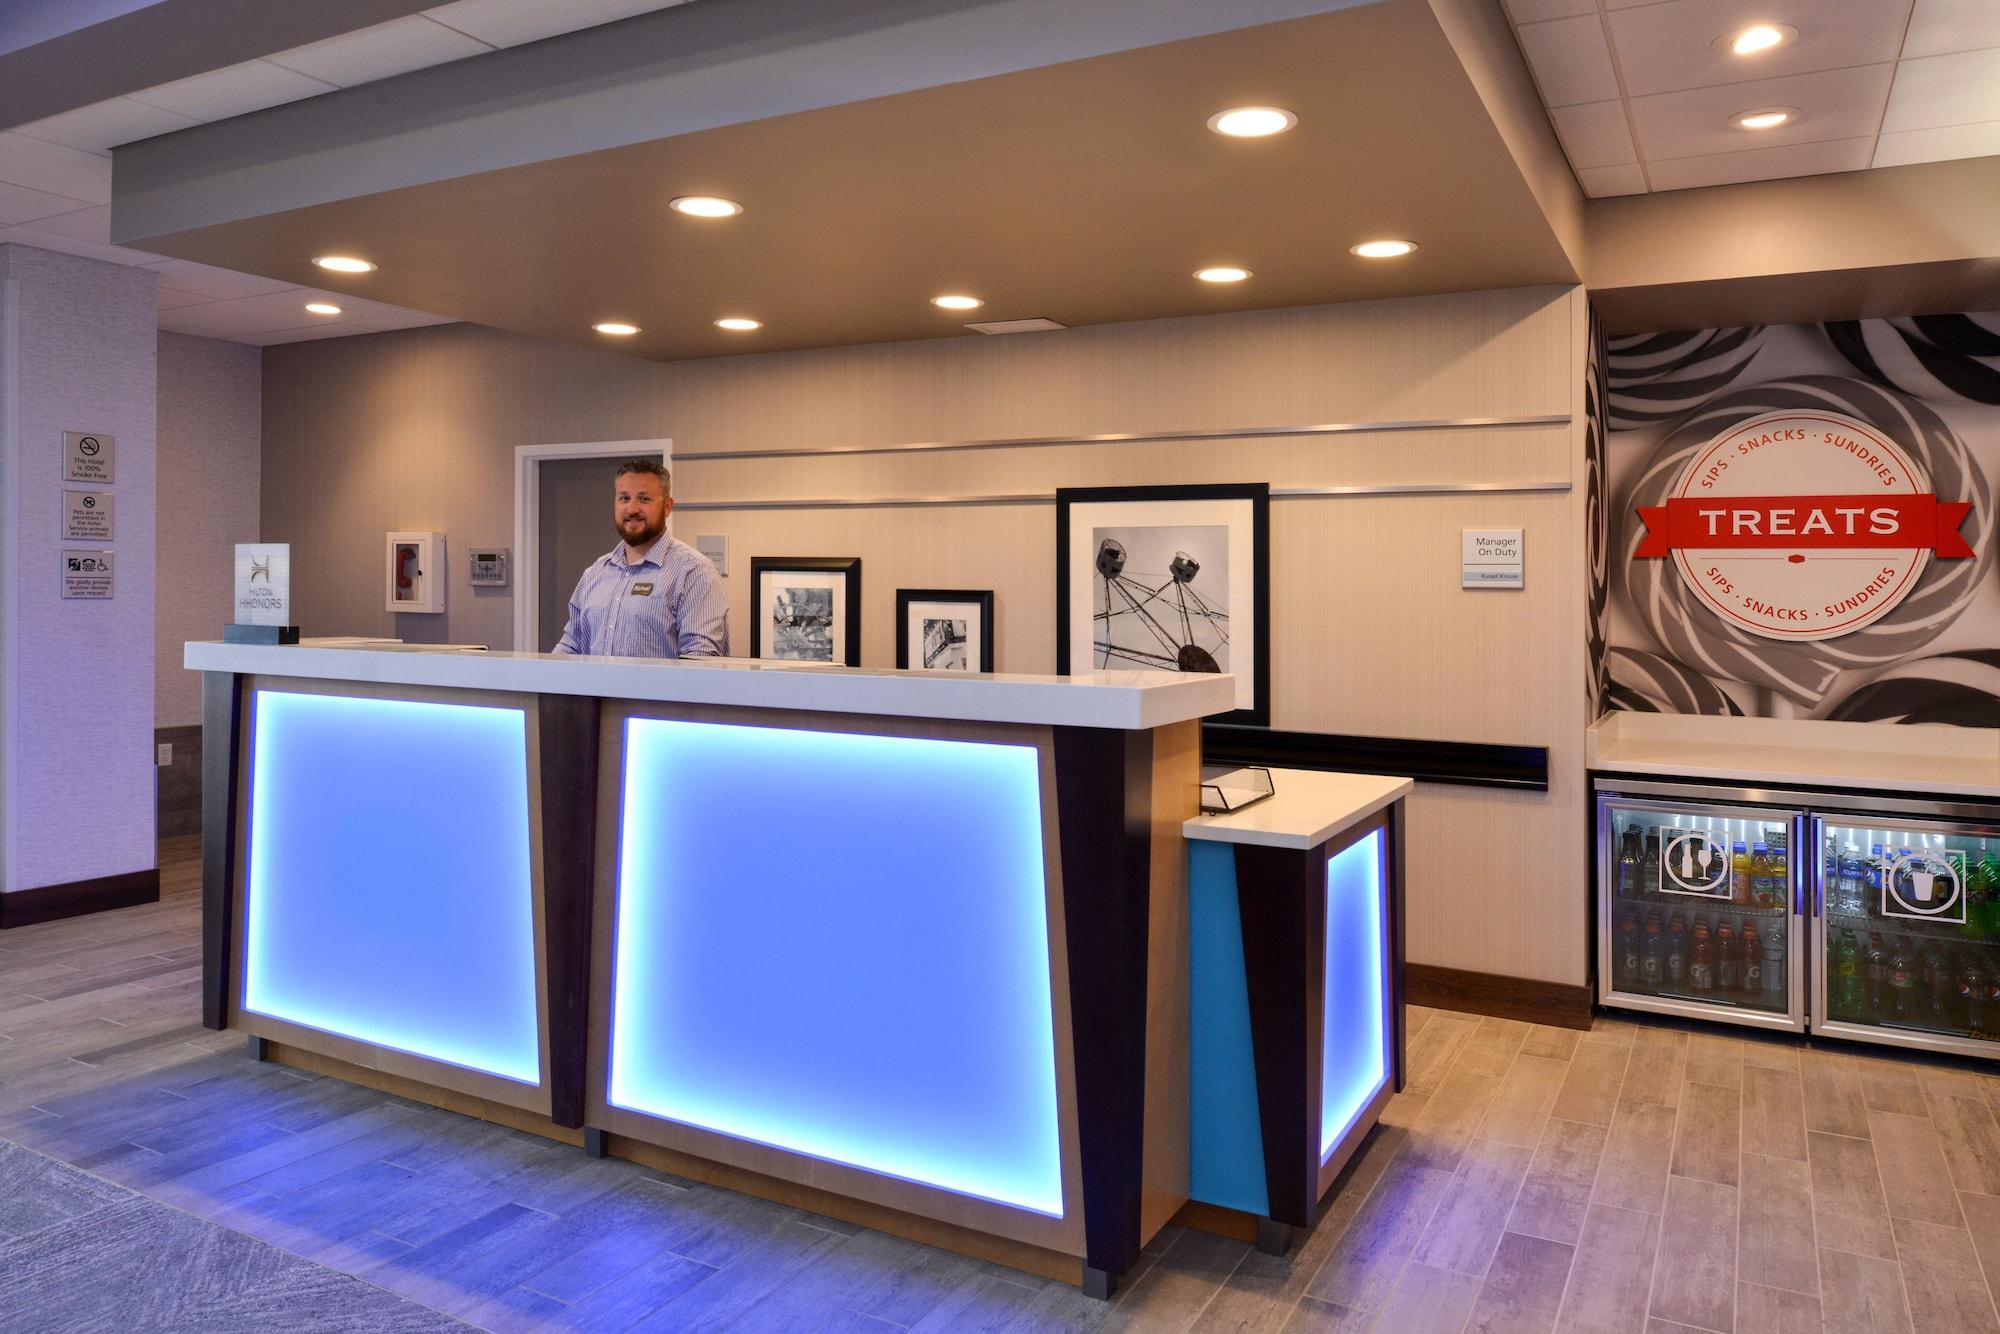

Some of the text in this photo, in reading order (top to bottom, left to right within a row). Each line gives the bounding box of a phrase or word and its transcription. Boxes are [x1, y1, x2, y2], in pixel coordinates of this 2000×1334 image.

[88, 458, 105, 466] Hotel
[1701, 428, 1897, 489] SIPS SNACKS SUNDRIES
[1698, 506, 1900, 536] TREATS
[1476, 537, 1517, 547] Manager
[1478, 548, 1517, 558] On Duty
[249, 587, 272, 597] HILTON
[1705, 566, 1896, 621] SIPS SNACKS SUNDRIES
[239, 598, 282, 609] HHONORS
